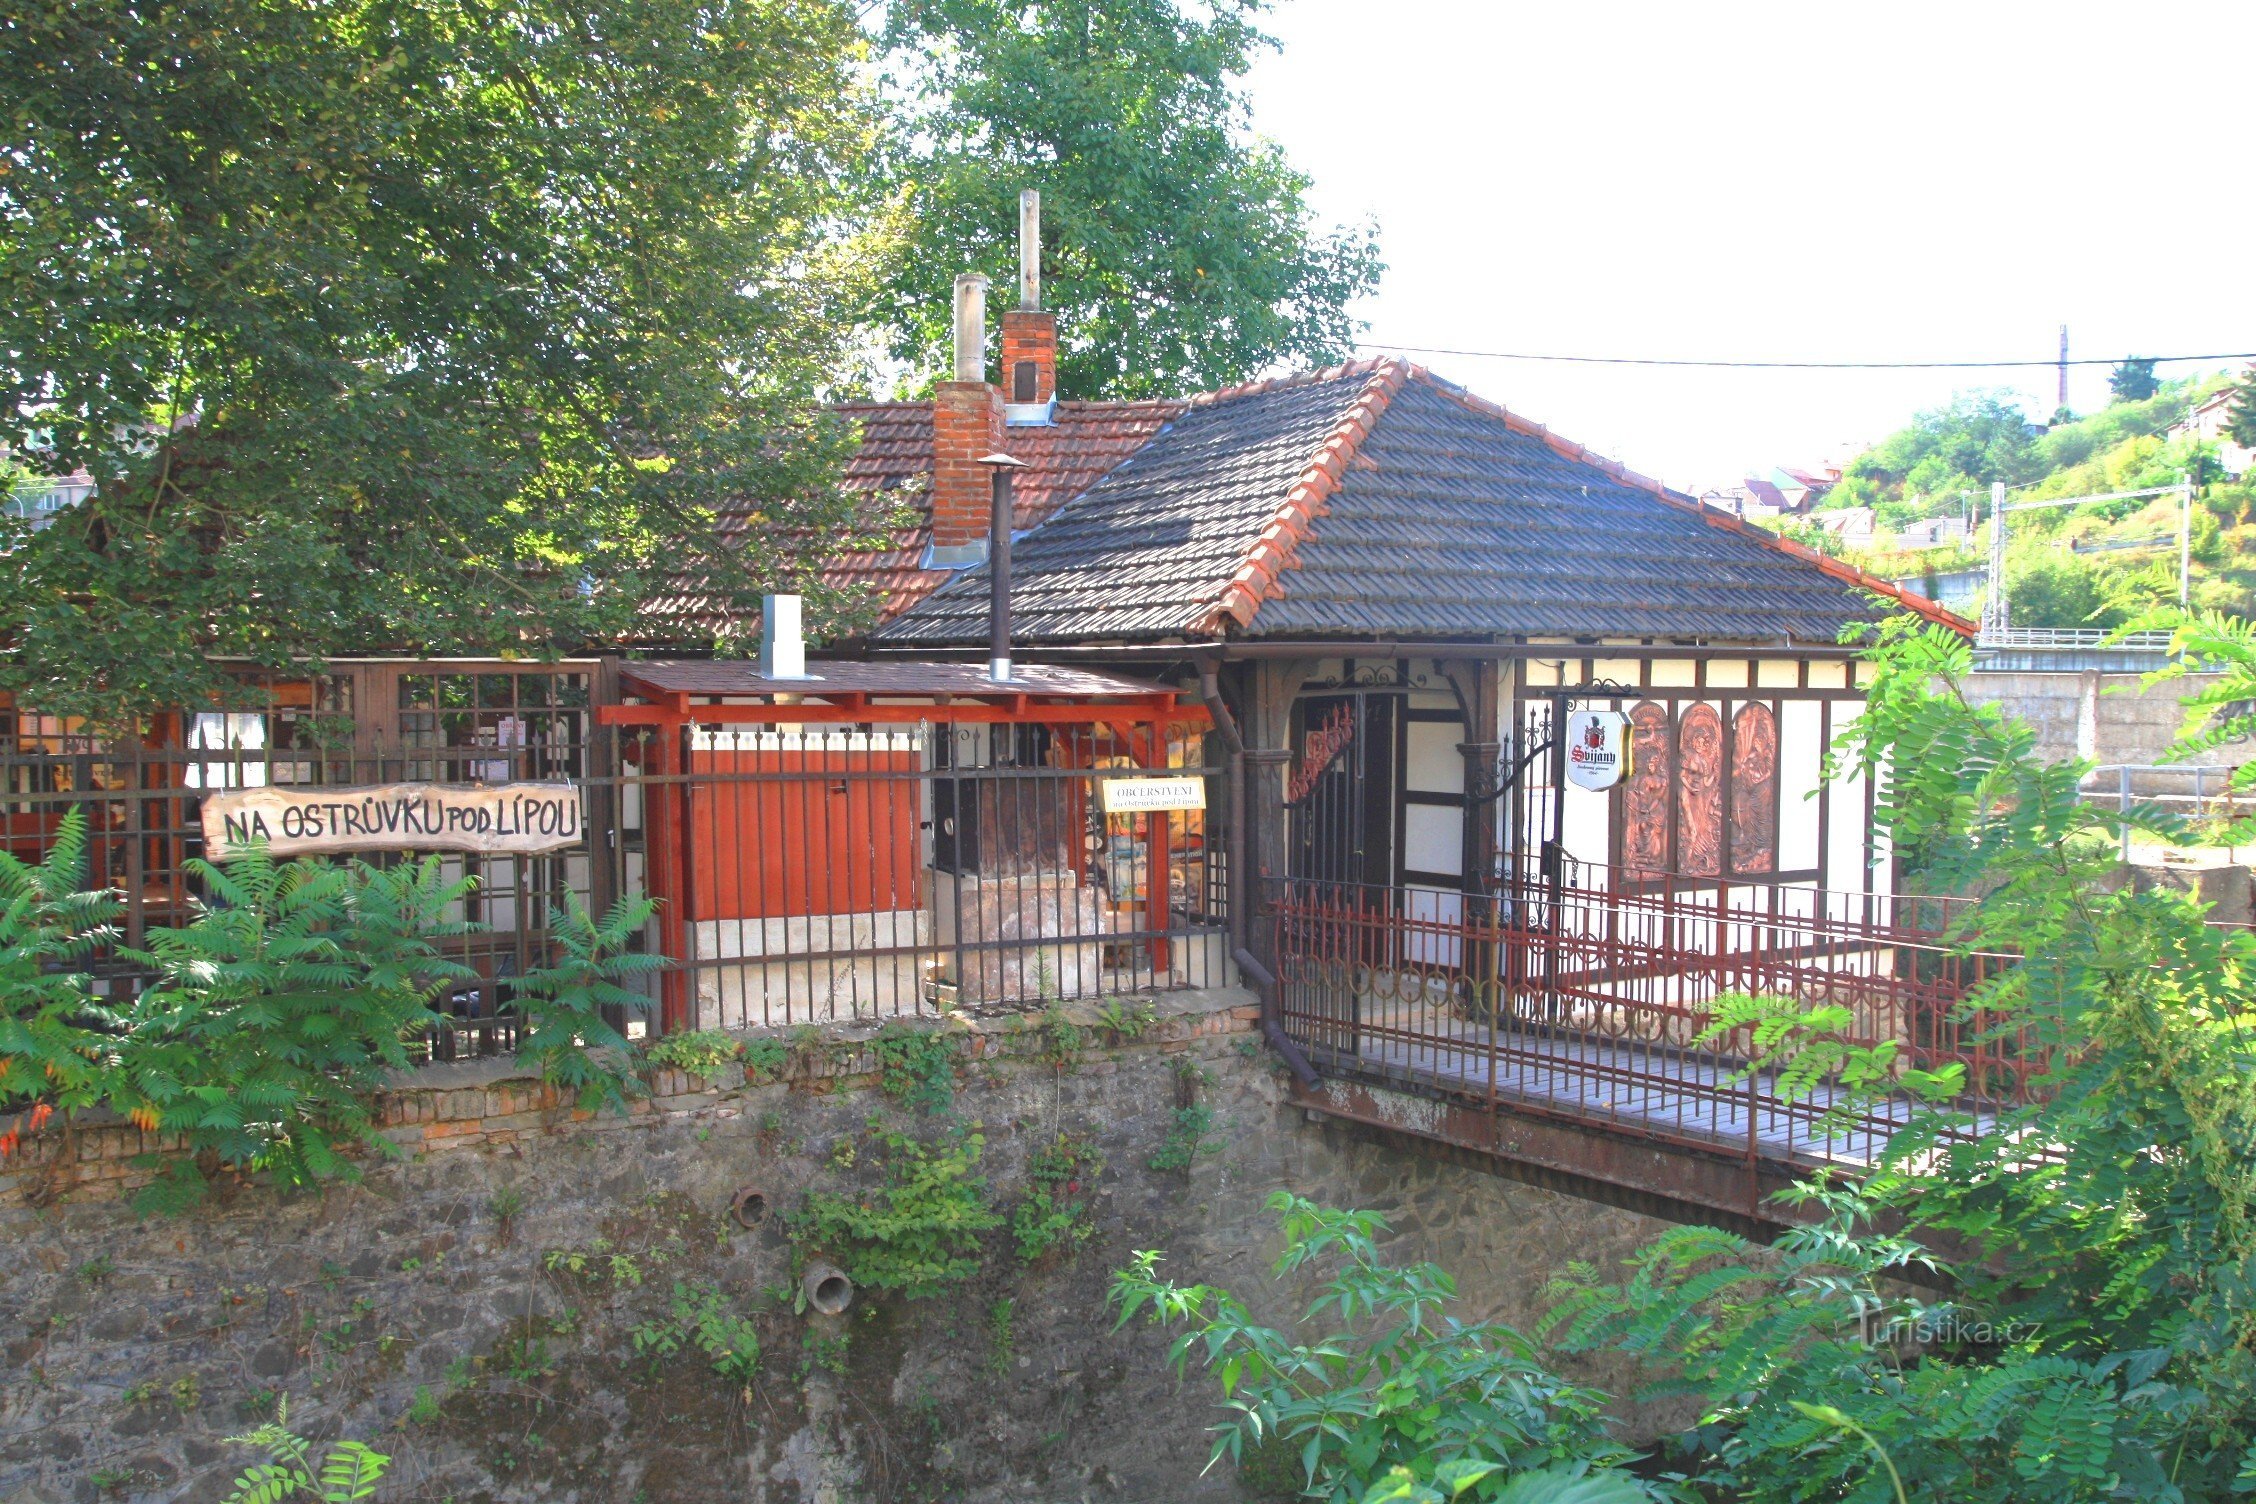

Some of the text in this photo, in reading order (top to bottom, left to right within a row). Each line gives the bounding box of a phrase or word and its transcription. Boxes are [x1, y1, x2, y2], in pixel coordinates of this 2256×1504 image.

[1571, 745, 1616, 764] Svijany
[223, 793, 577, 844] NA OSTRŮVKU POD LÍPOU
